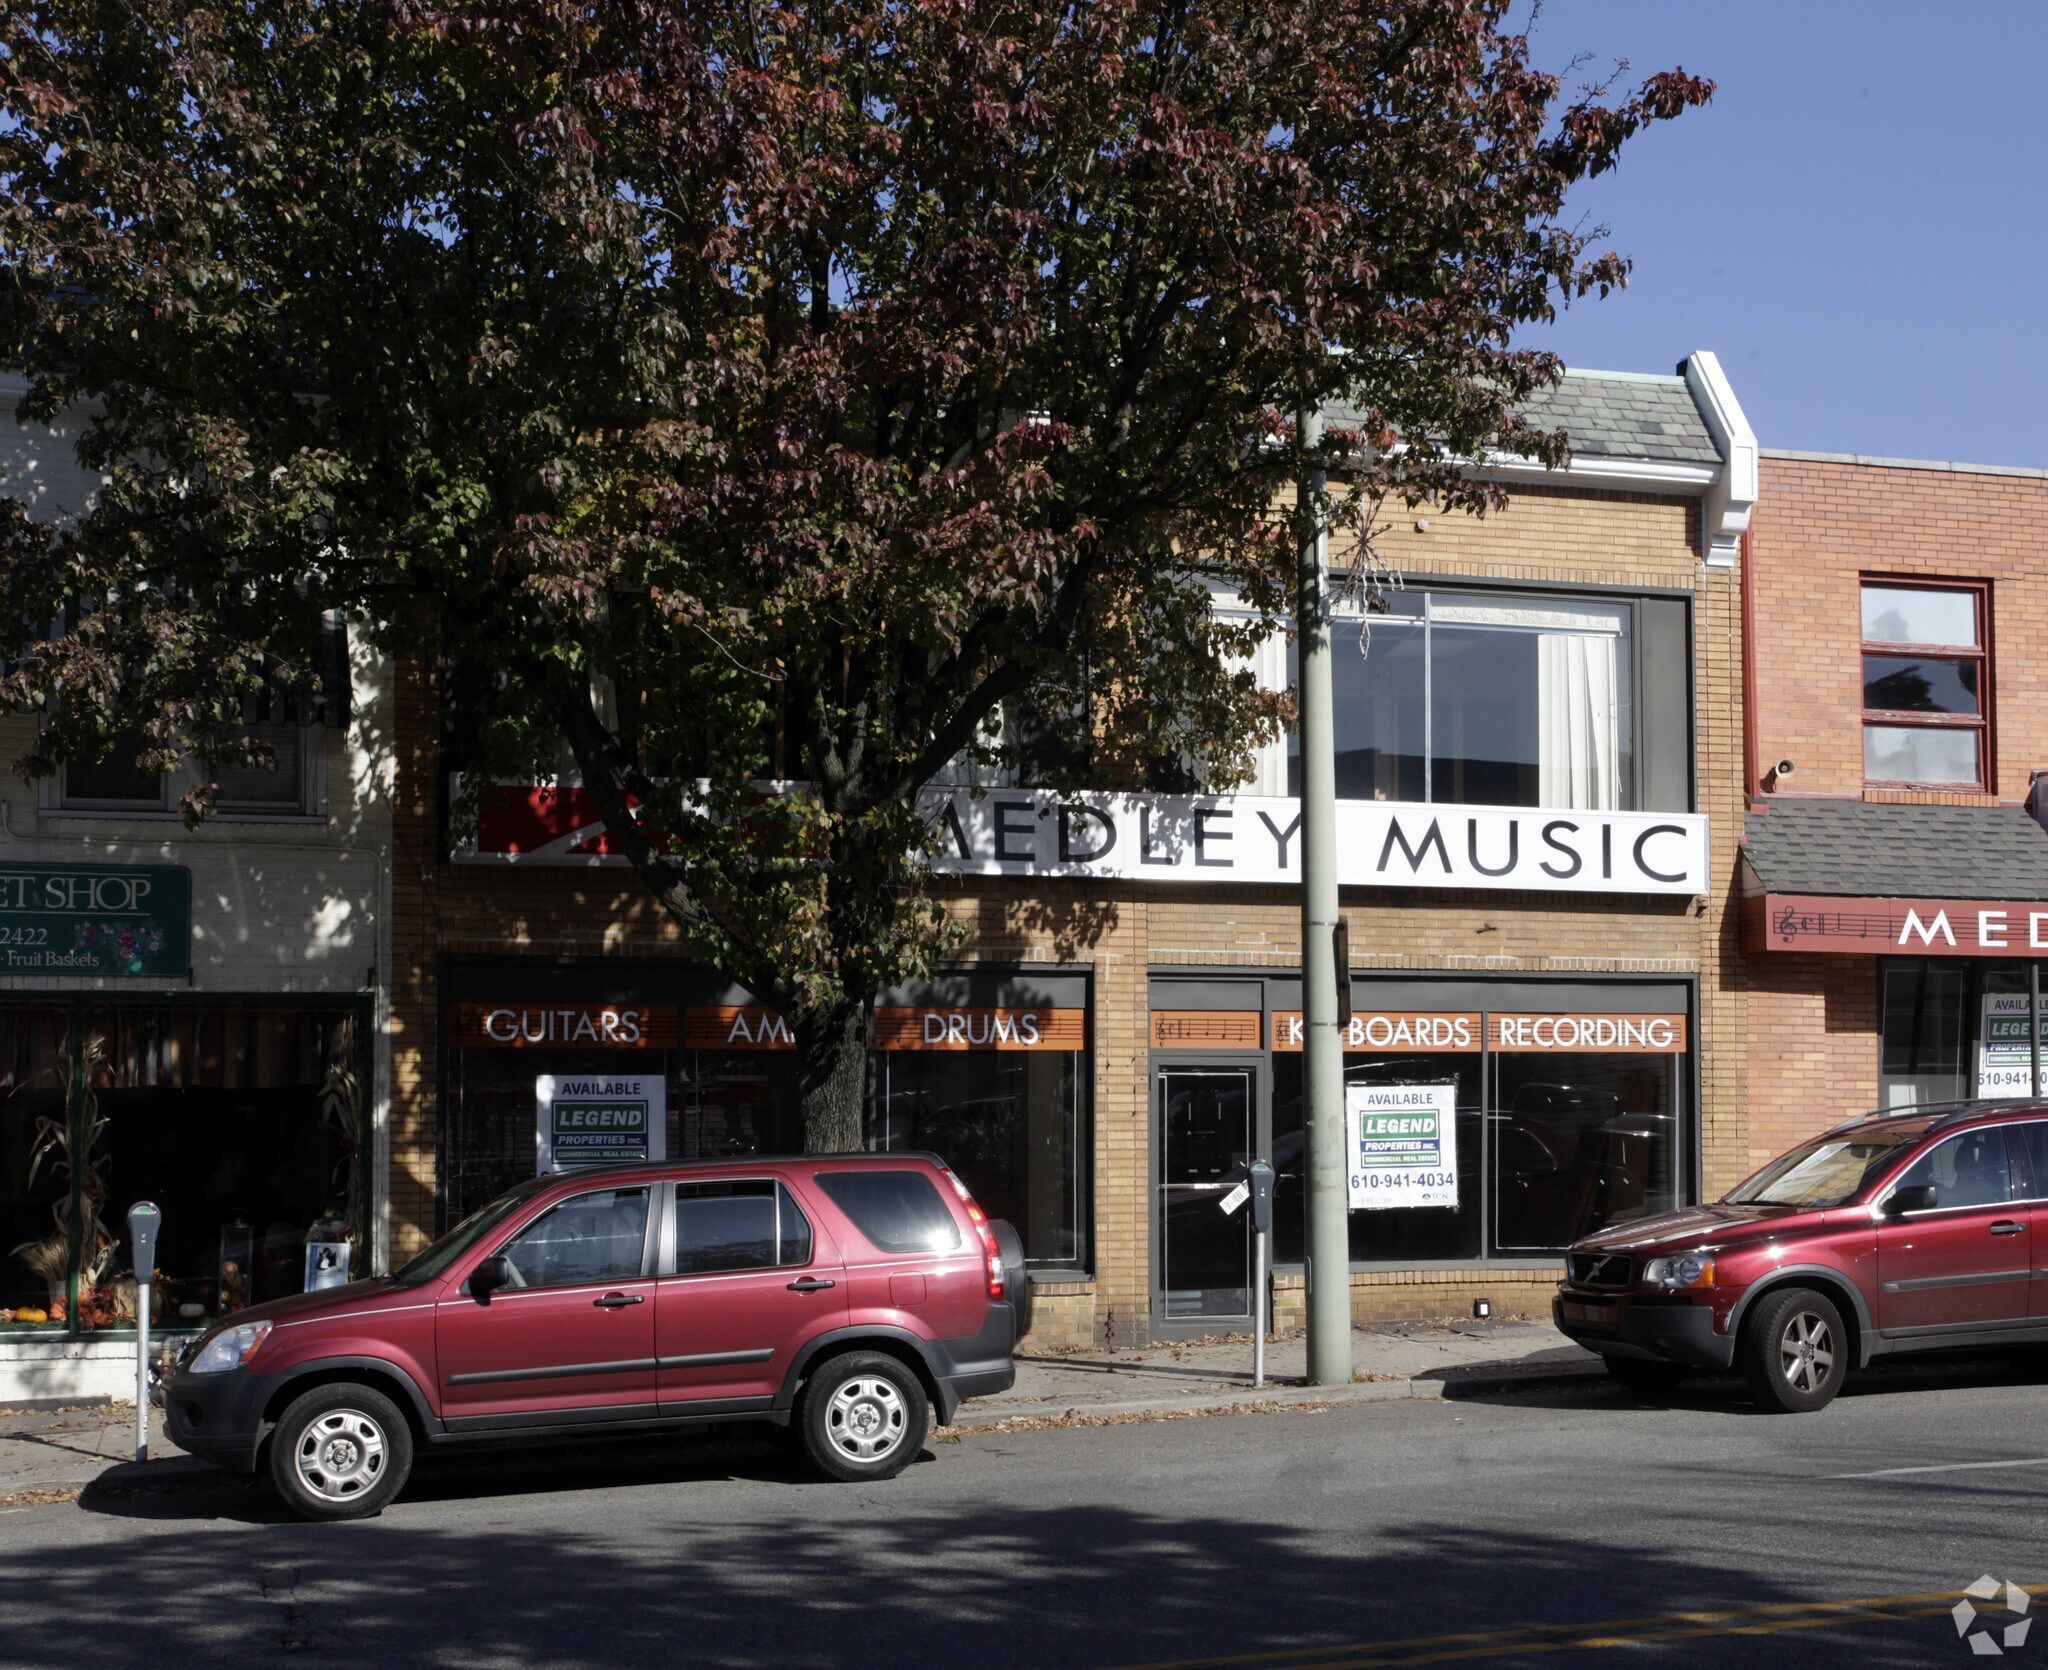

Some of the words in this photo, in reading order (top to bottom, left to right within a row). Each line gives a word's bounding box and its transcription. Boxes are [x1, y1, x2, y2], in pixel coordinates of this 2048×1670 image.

[1376, 814, 1687, 883] MUSIC
[45, 877, 151, 910] SHOP
[7, 950, 43, 967] Fruit
[45, 951, 100, 967] Baskets
[486, 1009, 641, 1043] GUITARS
[924, 1013, 1040, 1045] DRUMS
[1289, 1016, 1471, 1048] KBOARDS
[1500, 1017, 1675, 1048] RECORDING
[1991, 1022, 2048, 1036] LEGED
[562, 1083, 641, 1095] AVAILABLE
[1368, 1093, 1433, 1105] AVAILABLE
[559, 1110, 642, 1126] LEGEND
[1366, 1118, 1435, 1134] LEGEND
[558, 1135, 626, 1145] PROPERTIES
[627, 1137, 643, 1145] INC.
[1365, 1141, 1421, 1151] PROPERTIES
[620, 1150, 644, 1158] ESTATE
[1351, 1172, 1454, 1189] 610-941-4034
